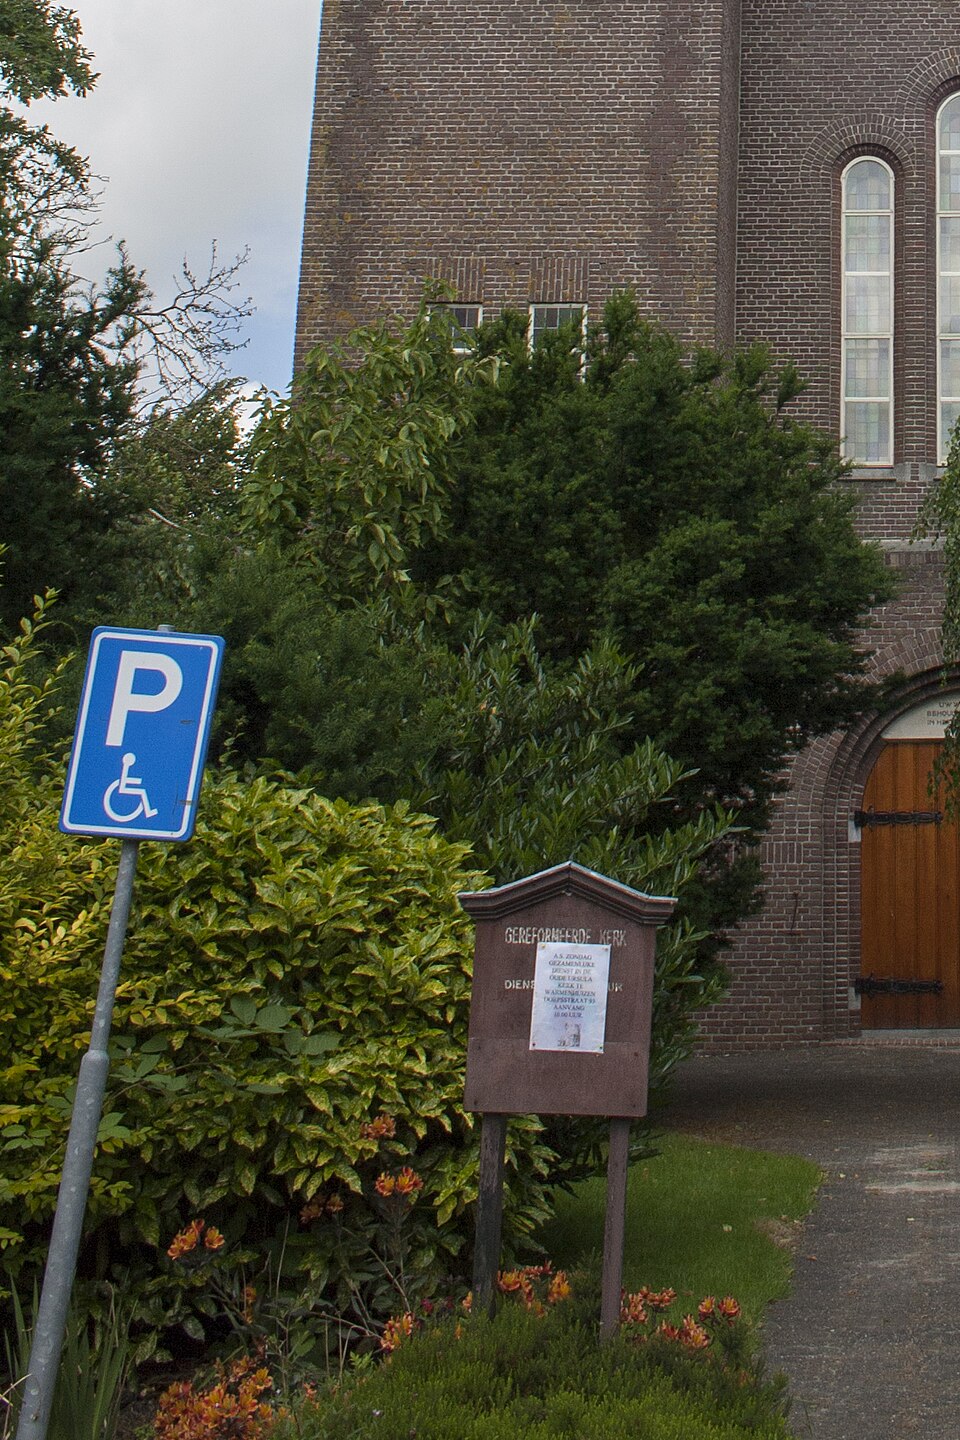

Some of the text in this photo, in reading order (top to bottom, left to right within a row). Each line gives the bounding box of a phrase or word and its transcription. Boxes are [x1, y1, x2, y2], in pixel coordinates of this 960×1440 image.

[105, 650, 184, 746] P
[504, 926, 627, 946] GEREFORMEERDE KERK
